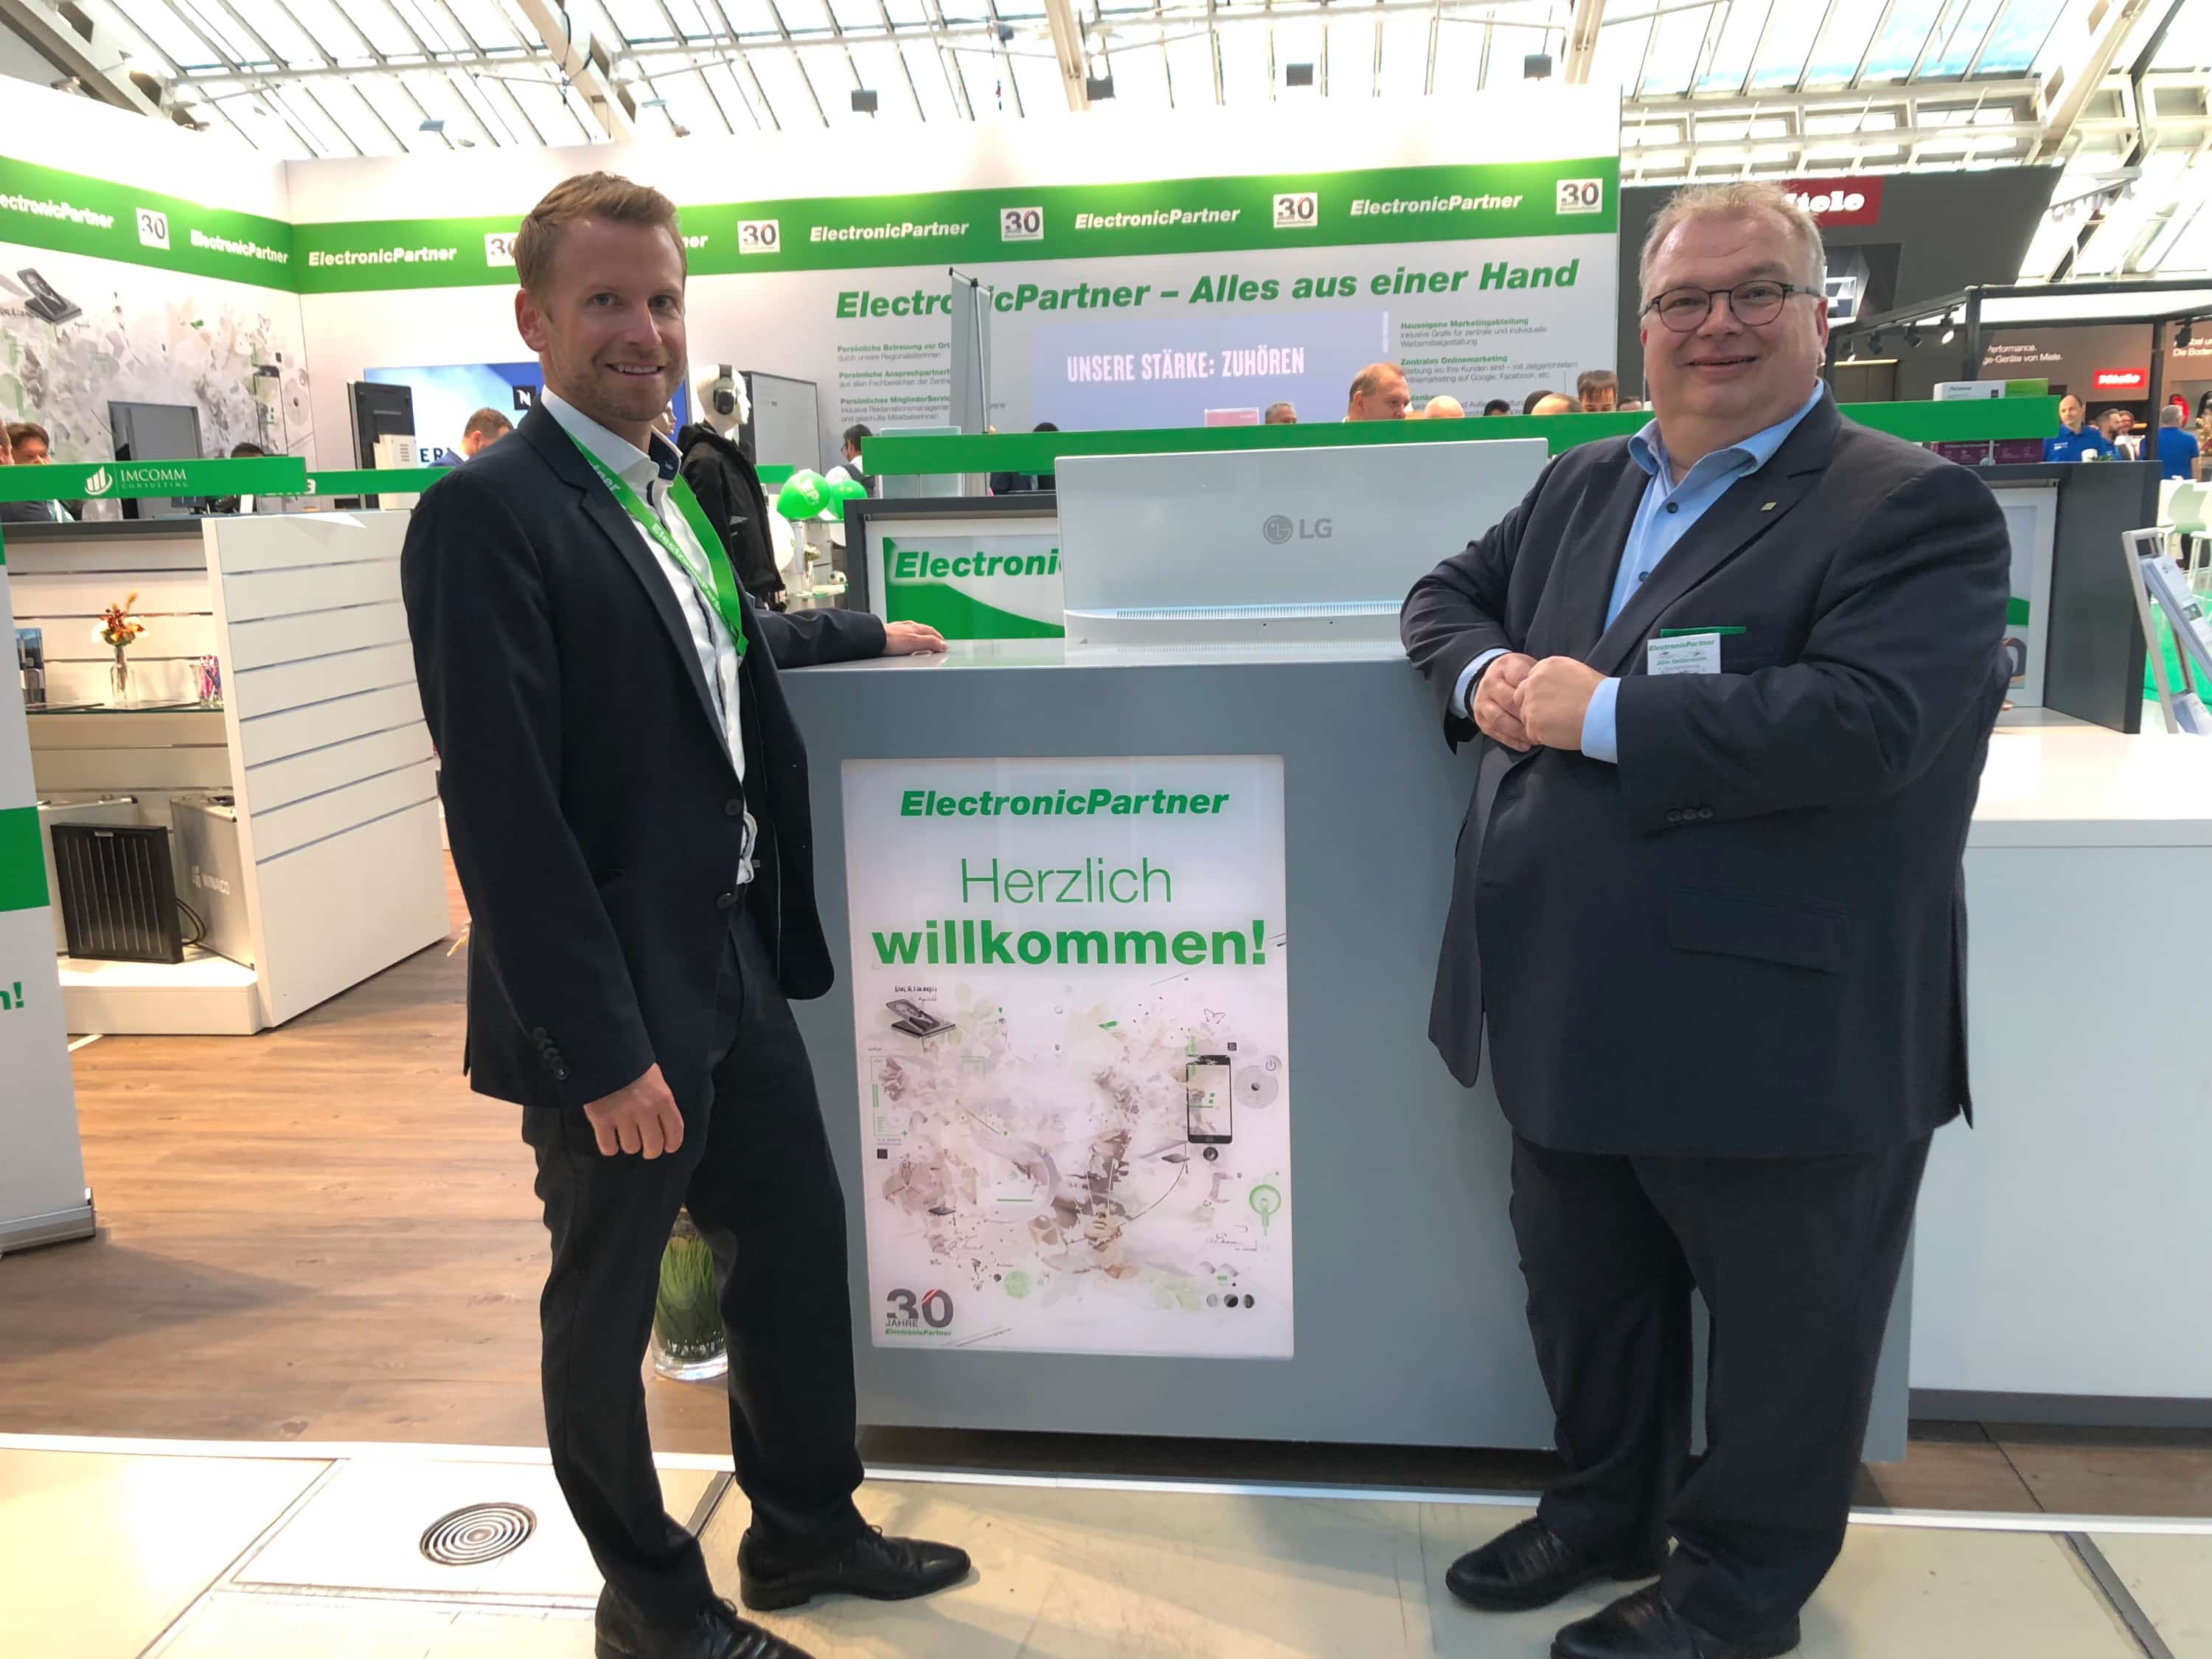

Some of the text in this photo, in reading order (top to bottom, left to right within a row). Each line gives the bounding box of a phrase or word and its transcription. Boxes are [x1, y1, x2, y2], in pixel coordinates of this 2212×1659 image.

[1562, 182, 1599, 205] 30
[1278, 197, 1314, 219] 30
[1350, 194, 1523, 215] ElectronicPartner
[141, 215, 166, 240] 30
[1006, 211, 1040, 233] 30
[1075, 209, 1240, 230] ElectronicPartner
[743, 224, 776, 246] 30
[810, 222, 969, 242] ElectronicPartner
[190, 229, 288, 263] ElectronicPartner
[308, 246, 457, 266] ElectronicPartner
[1189, 274, 1279, 303] Alles
[1292, 275, 1357, 299] aus
[1370, 266, 1468, 294] einer
[1479, 258, 1579, 291] Hand
[1401, 318, 1529, 330] Hauseigene Marketingabteilung
[838, 344, 881, 353] Persönliche
[883, 344, 922, 352] Betreuung
[1067, 344, 1304, 382] UNSERE STÄRKE: ZUHÖREN
[1401, 355, 1508, 366] Zentrales Onlinemarketing
[839, 370, 883, 379] Persönliche
[841, 396, 888, 405] Persönliches
[120, 468, 187, 482] IMCOMM
[121, 481, 189, 490] CONSULTING
[1299, 518, 1333, 539] LG
[895, 549, 1062, 578] Electroni
[900, 788, 1229, 817] ElectronicPartner
[961, 857, 1172, 903] Herzlich
[872, 919, 1266, 966] willkommen!
[886, 1288, 954, 1328] 30
[885, 1329, 952, 1337] ElectronicPartner
[886, 1319, 919, 1328] JAHRE
